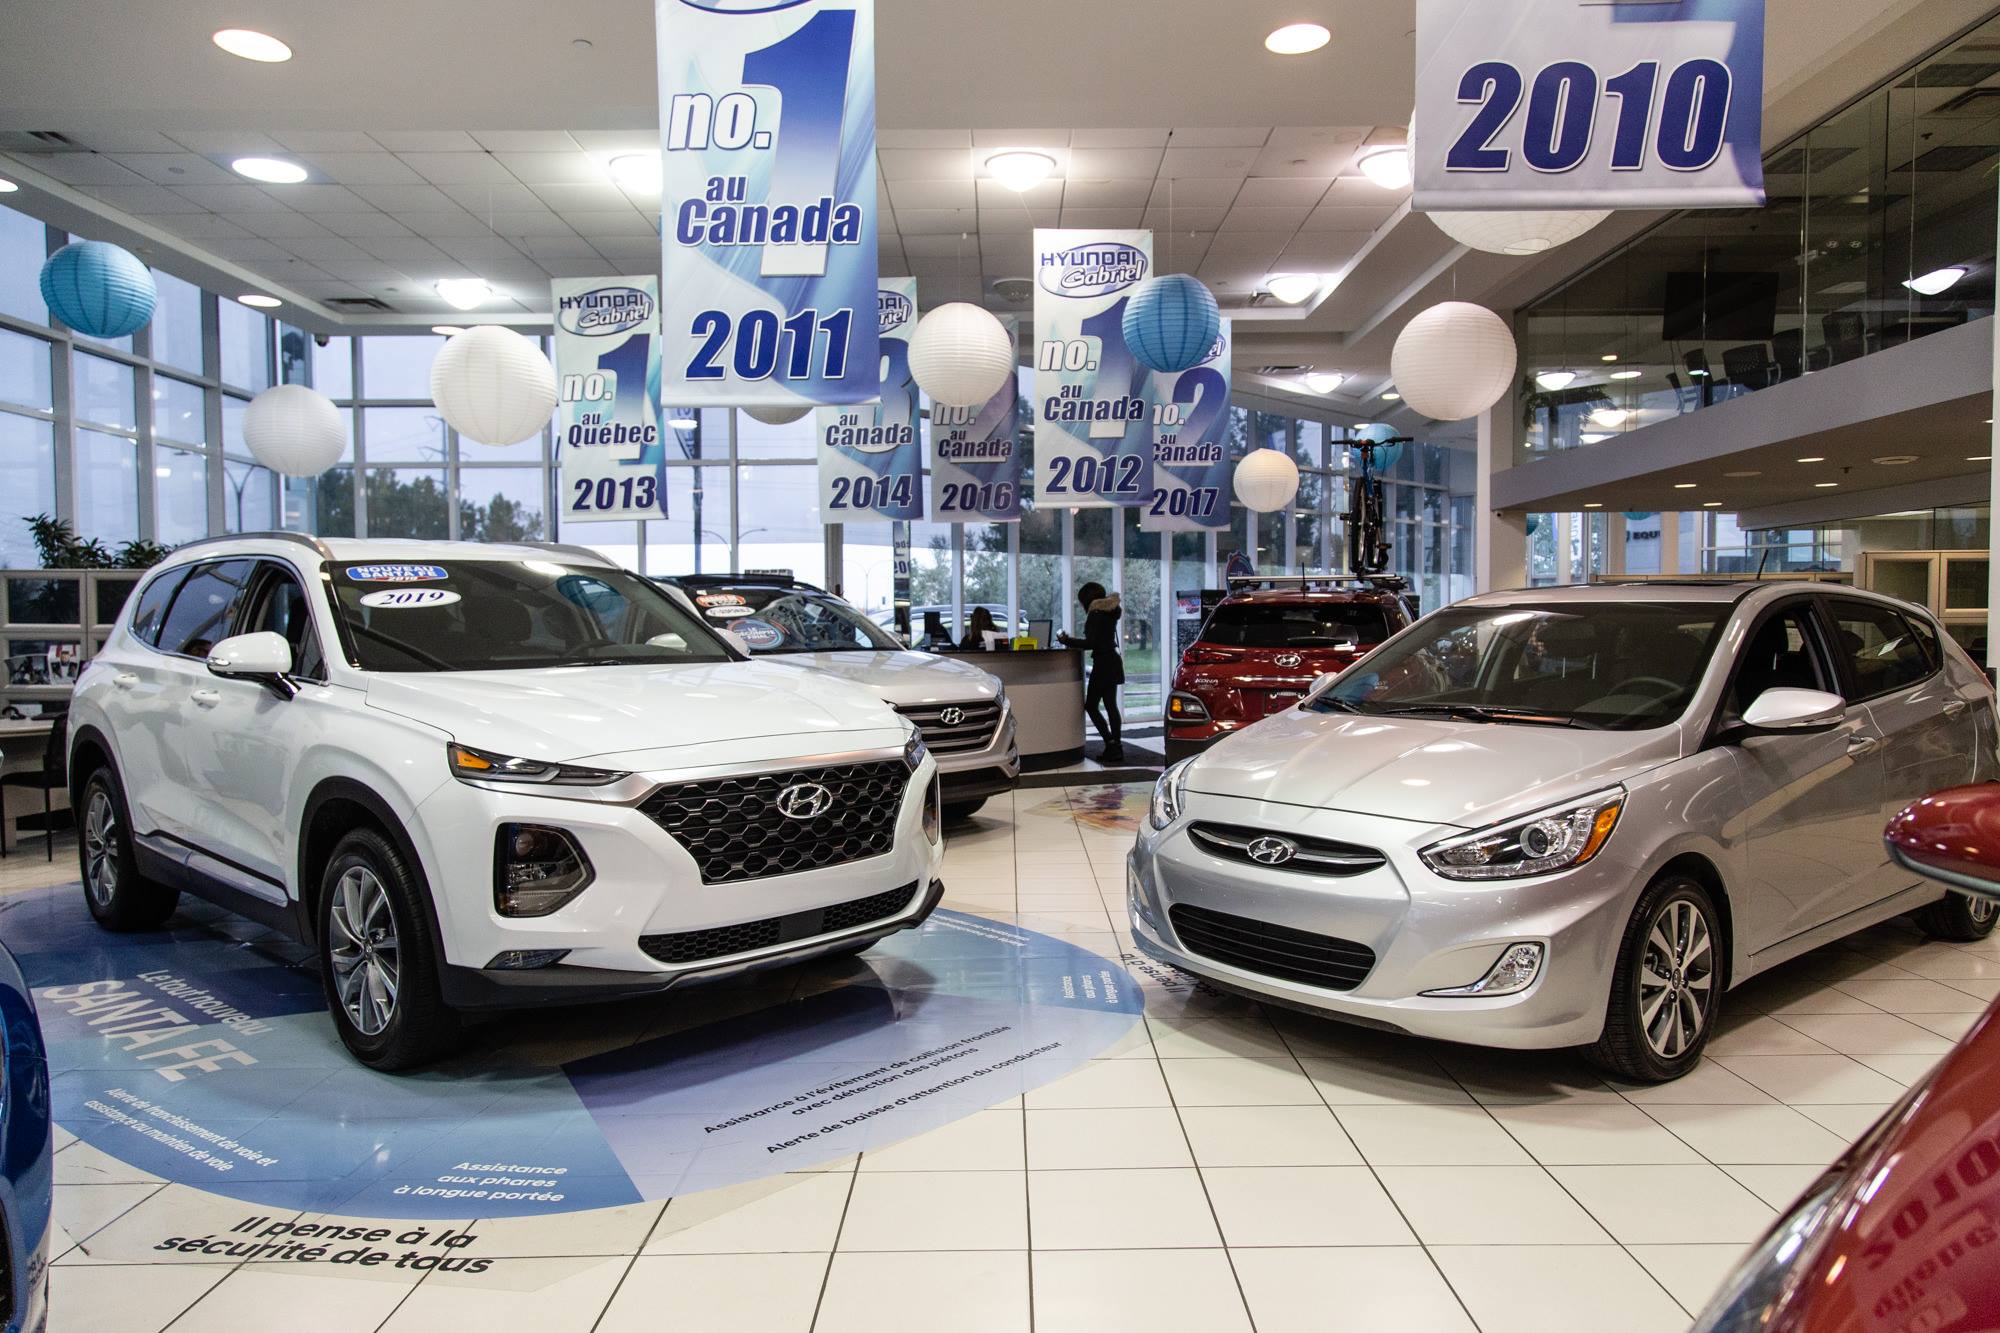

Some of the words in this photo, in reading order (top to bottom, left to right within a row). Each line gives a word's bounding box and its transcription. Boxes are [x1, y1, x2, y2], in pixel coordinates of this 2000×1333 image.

[1446, 58, 1733, 173] 2010
[667, 92, 772, 151] no.
[741, 9, 857, 277] 1
[705, 176, 747, 202] au
[676, 196, 862, 246] Canada
[1041, 251, 1137, 267] HYUNDAI
[1061, 260, 1144, 288] Gabriel
[560, 294, 644, 309] HYUNDAI
[578, 302, 650, 328] Gabriel
[685, 308, 853, 381] 2011
[1039, 340, 1097, 371] no.
[562, 373, 613, 402] no.
[597, 333, 651, 460] 1
[1060, 385, 1082, 398] au
[582, 413, 601, 425] au
[839, 414, 858, 426] au
[1044, 396, 1145, 421] Canada
[568, 422, 657, 448] Québec
[825, 424, 913, 447] Canada
[938, 438, 1012, 458] Canada
[951, 430, 966, 441] au
[1160, 434, 1177, 445] au
[1045, 455, 1144, 493] 2012
[573, 475, 657, 510] 2013
[829, 474, 913, 509] 2014
[939, 481, 1014, 511] 2016
[1150, 488, 1218, 516] 2017
[356, 565, 434, 574] NOUVEAU
[378, 592, 445, 606] 2019
[1194, 677, 1219, 686] KONA
[136, 969, 171, 983] Le
[155, 978, 209, 999] tout
[184, 995, 273, 1035] nouveau
[43, 979, 200, 1051] SANTA
[136, 1038, 259, 1082] FE
[704, 1099, 795, 1134] Assistance
[795, 1092, 808, 1102] à
[806, 1065, 891, 1097] l'évitement
[890, 1060, 910, 1069] de
[909, 1039, 963, 1062] collision
[961, 1025, 1011, 1044] frontale
[791, 1099, 832, 1116] avec
[831, 1074, 904, 1102] détection
[903, 1064, 930, 1076] des
[929, 1047, 979, 1068] piétons
[766, 1132, 820, 1153] Alerte
[820, 1123, 843, 1134] de
[841, 1104, 896, 1125] baisse
[894, 1074, 973, 1106] d'attention
[972, 1066, 992, 1077] du
[990, 1041, 1063, 1070] conducteur
[84, 1100, 138, 1125] assistance
[131, 1122, 153, 1132] au
[143, 1128, 195, 1153] maintien
[188, 1150, 209, 1160] de
[203, 1157, 234, 1171] voie
[104, 1088, 138, 1103] Alerte
[131, 1100, 151, 1109] de
[143, 1105, 227, 1143] franchissement
[217, 1140, 239, 1149] de
[232, 1146, 263, 1160] voie
[256, 1157, 280, 1167] et
[437, 1175, 480, 1184] aux
[479, 1176, 558, 1187] phares
[452, 1162, 568, 1175] Assistance
[393, 1185, 411, 1194] à
[412, 1186, 489, 1198] longue
[487, 1190, 565, 1202] portée
[230, 1216, 271, 1233] Il
[255, 1221, 392, 1242] pense
[395, 1226, 430, 1245] à
[429, 1229, 479, 1249] la
[153, 1234, 329, 1262] sécurité
[329, 1246, 390, 1266] de
[394, 1250, 495, 1274] tous
